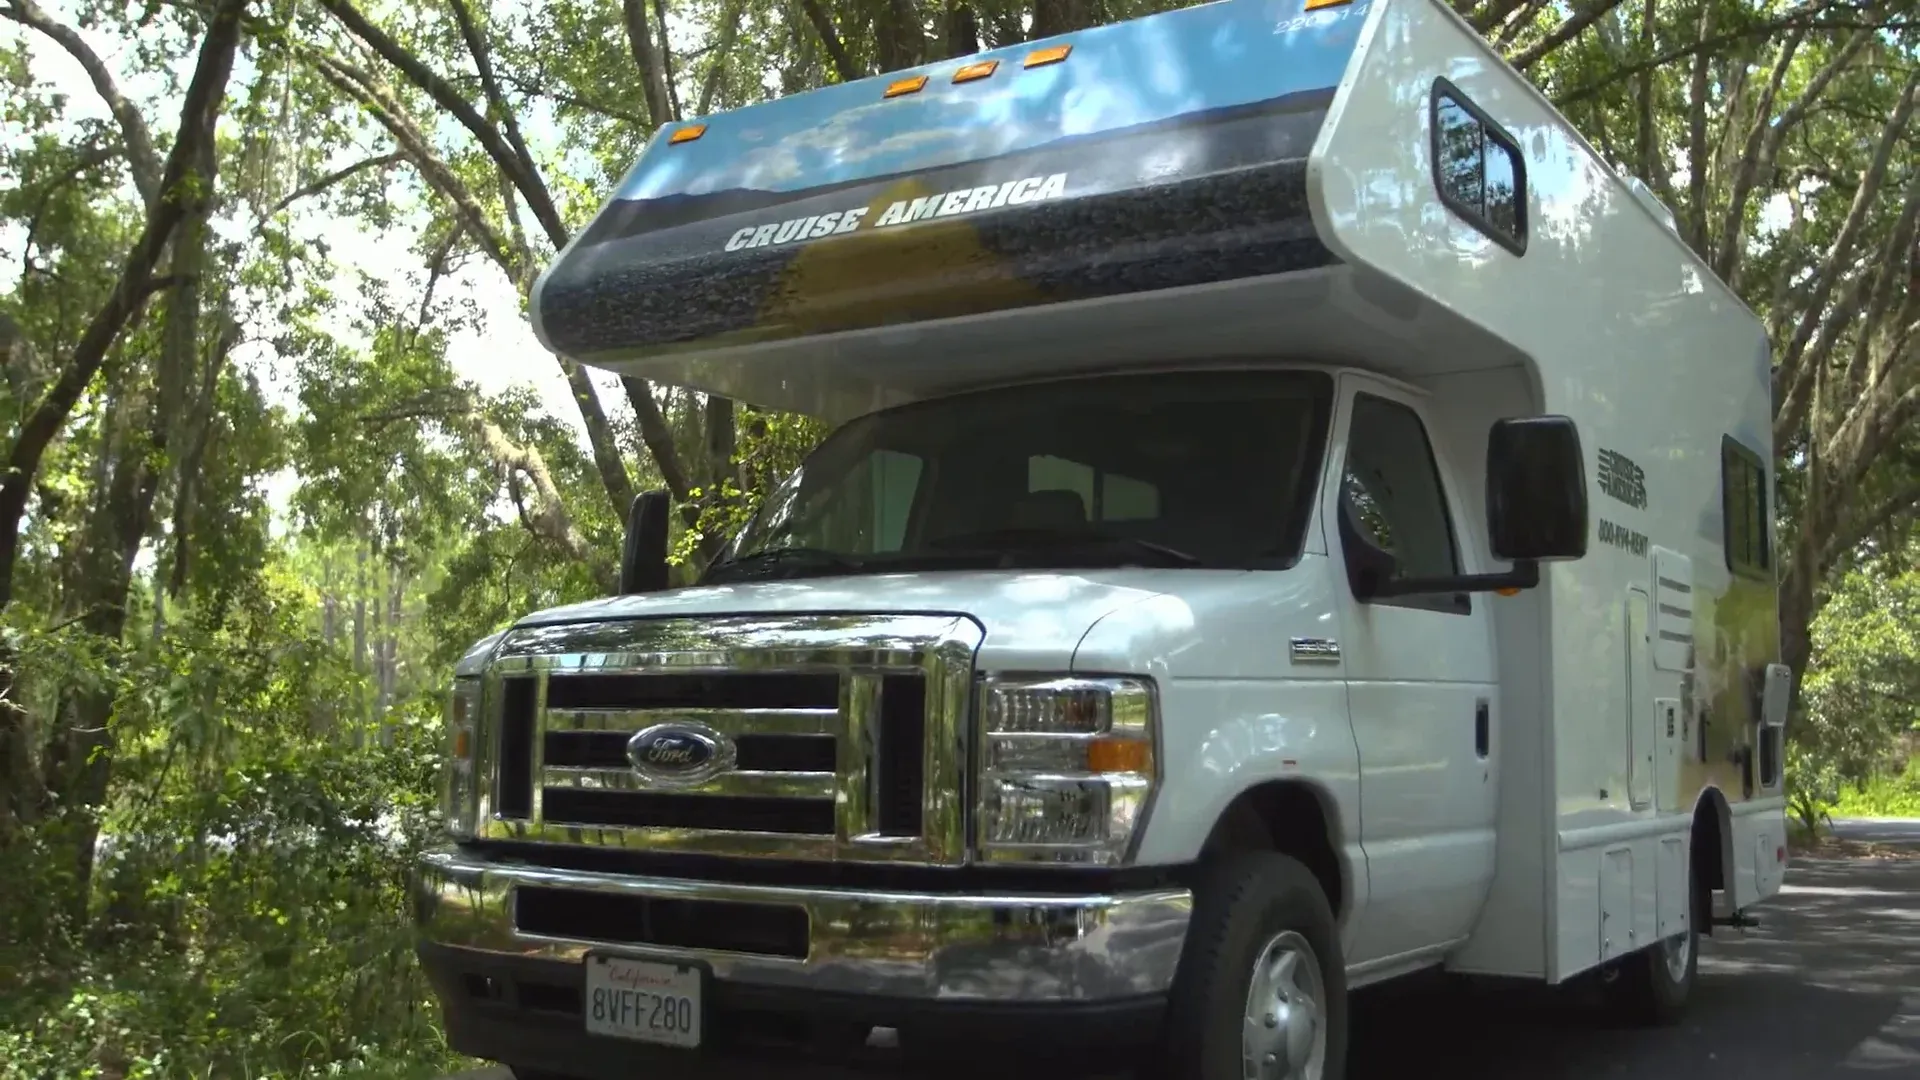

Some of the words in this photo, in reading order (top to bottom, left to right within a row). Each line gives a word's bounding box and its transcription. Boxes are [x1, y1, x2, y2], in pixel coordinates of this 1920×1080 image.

[724, 206, 869, 252] CRUISE
[874, 172, 1068, 227] AMERICA
[648, 737, 696, 762] Ford
[609, 965, 671, 990] California
[592, 986, 691, 1034] 8VFF280
